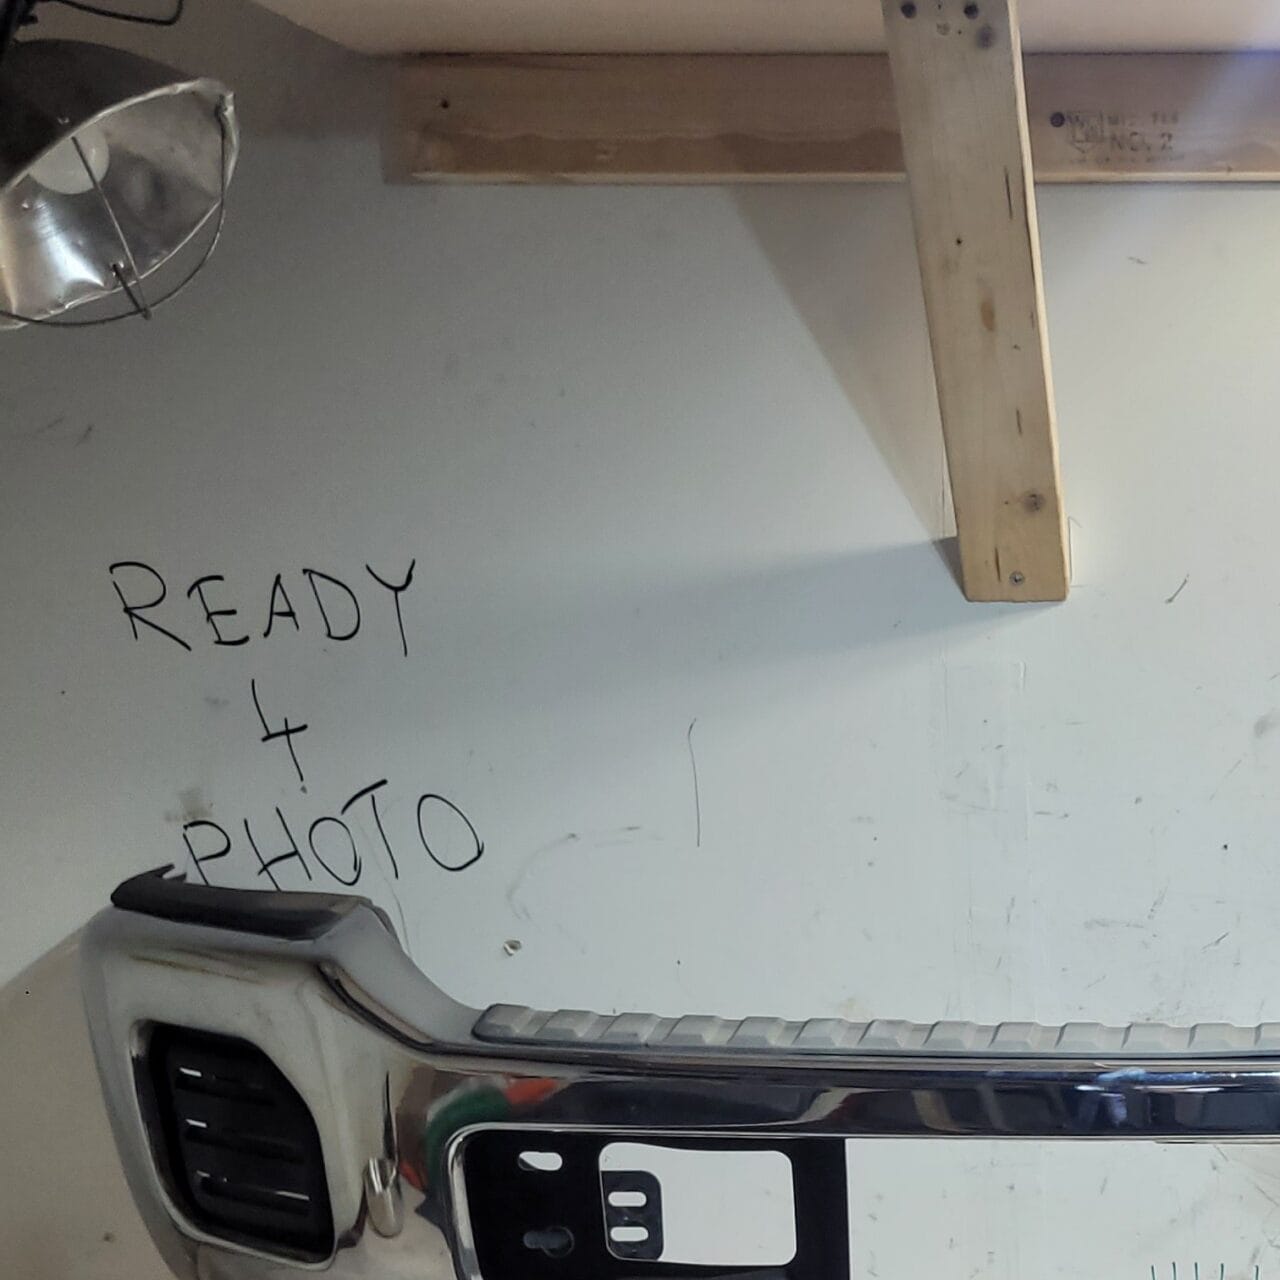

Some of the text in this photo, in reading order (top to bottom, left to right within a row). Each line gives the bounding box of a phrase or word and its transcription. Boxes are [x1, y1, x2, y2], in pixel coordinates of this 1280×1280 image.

[108, 558, 417, 657] READY
[251, 678, 309, 784] 4
[181, 779, 485, 891] PHOTO
